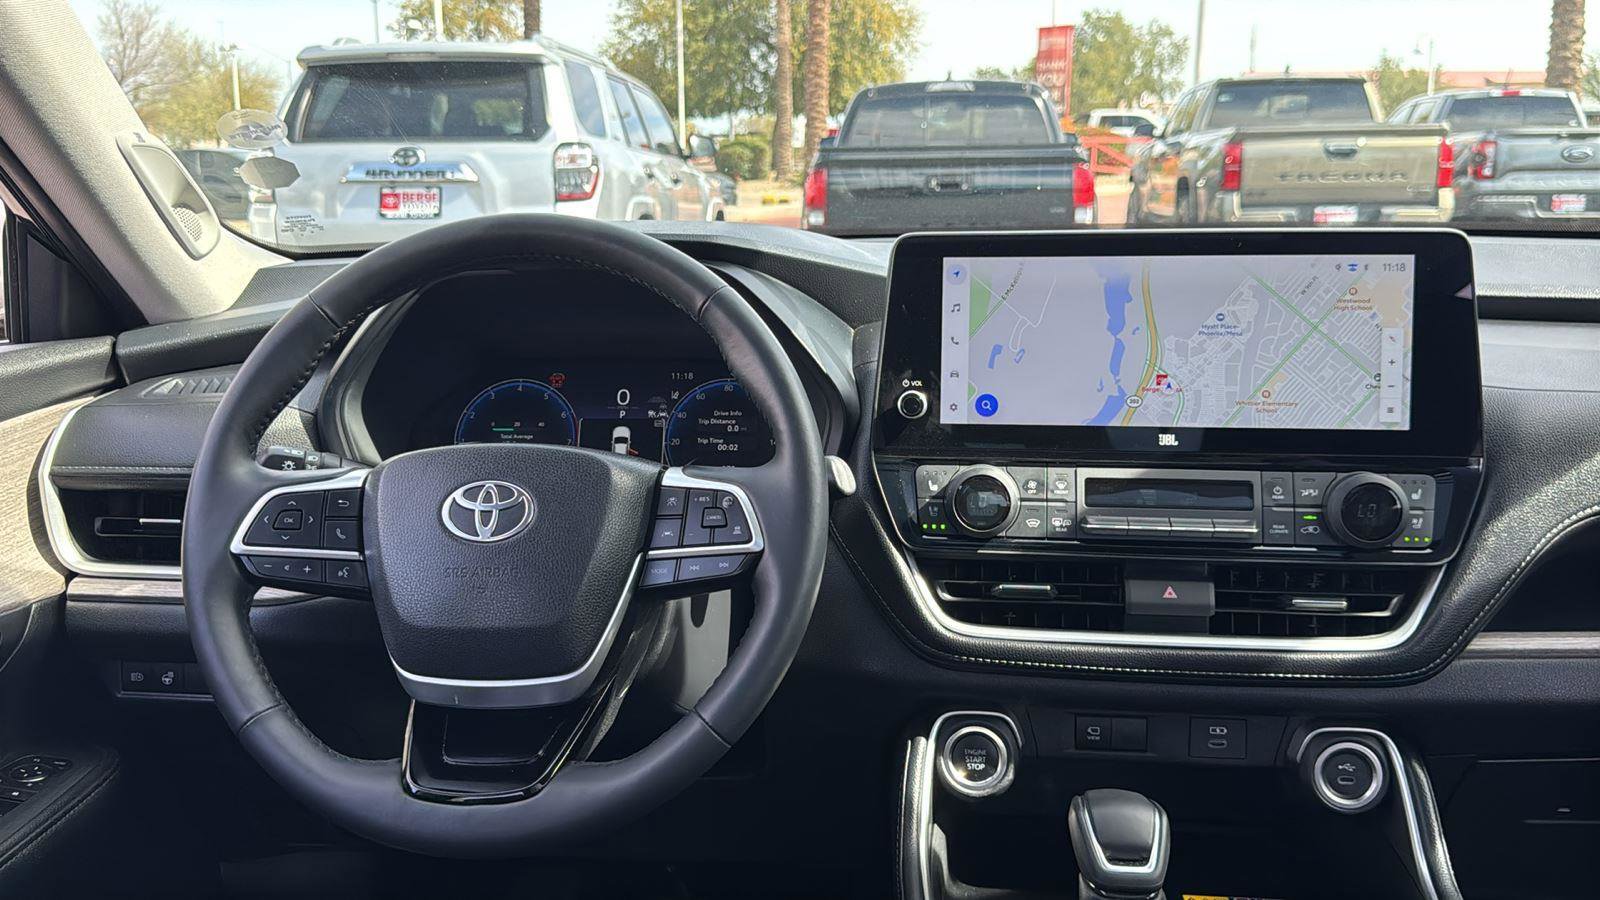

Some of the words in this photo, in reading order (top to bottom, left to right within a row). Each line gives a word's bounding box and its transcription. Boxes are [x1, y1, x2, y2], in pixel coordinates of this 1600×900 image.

[402, 191, 437, 202] BERGE
[1383, 263, 1406, 272] 11:18
[671, 372, 694, 380] 11:18
[617, 389, 631, 406] 0
[620, 410, 626, 419] P
[671, 438, 681, 446] 20
[1158, 434, 1179, 446] JBL
[966, 763, 986, 771] STOP
